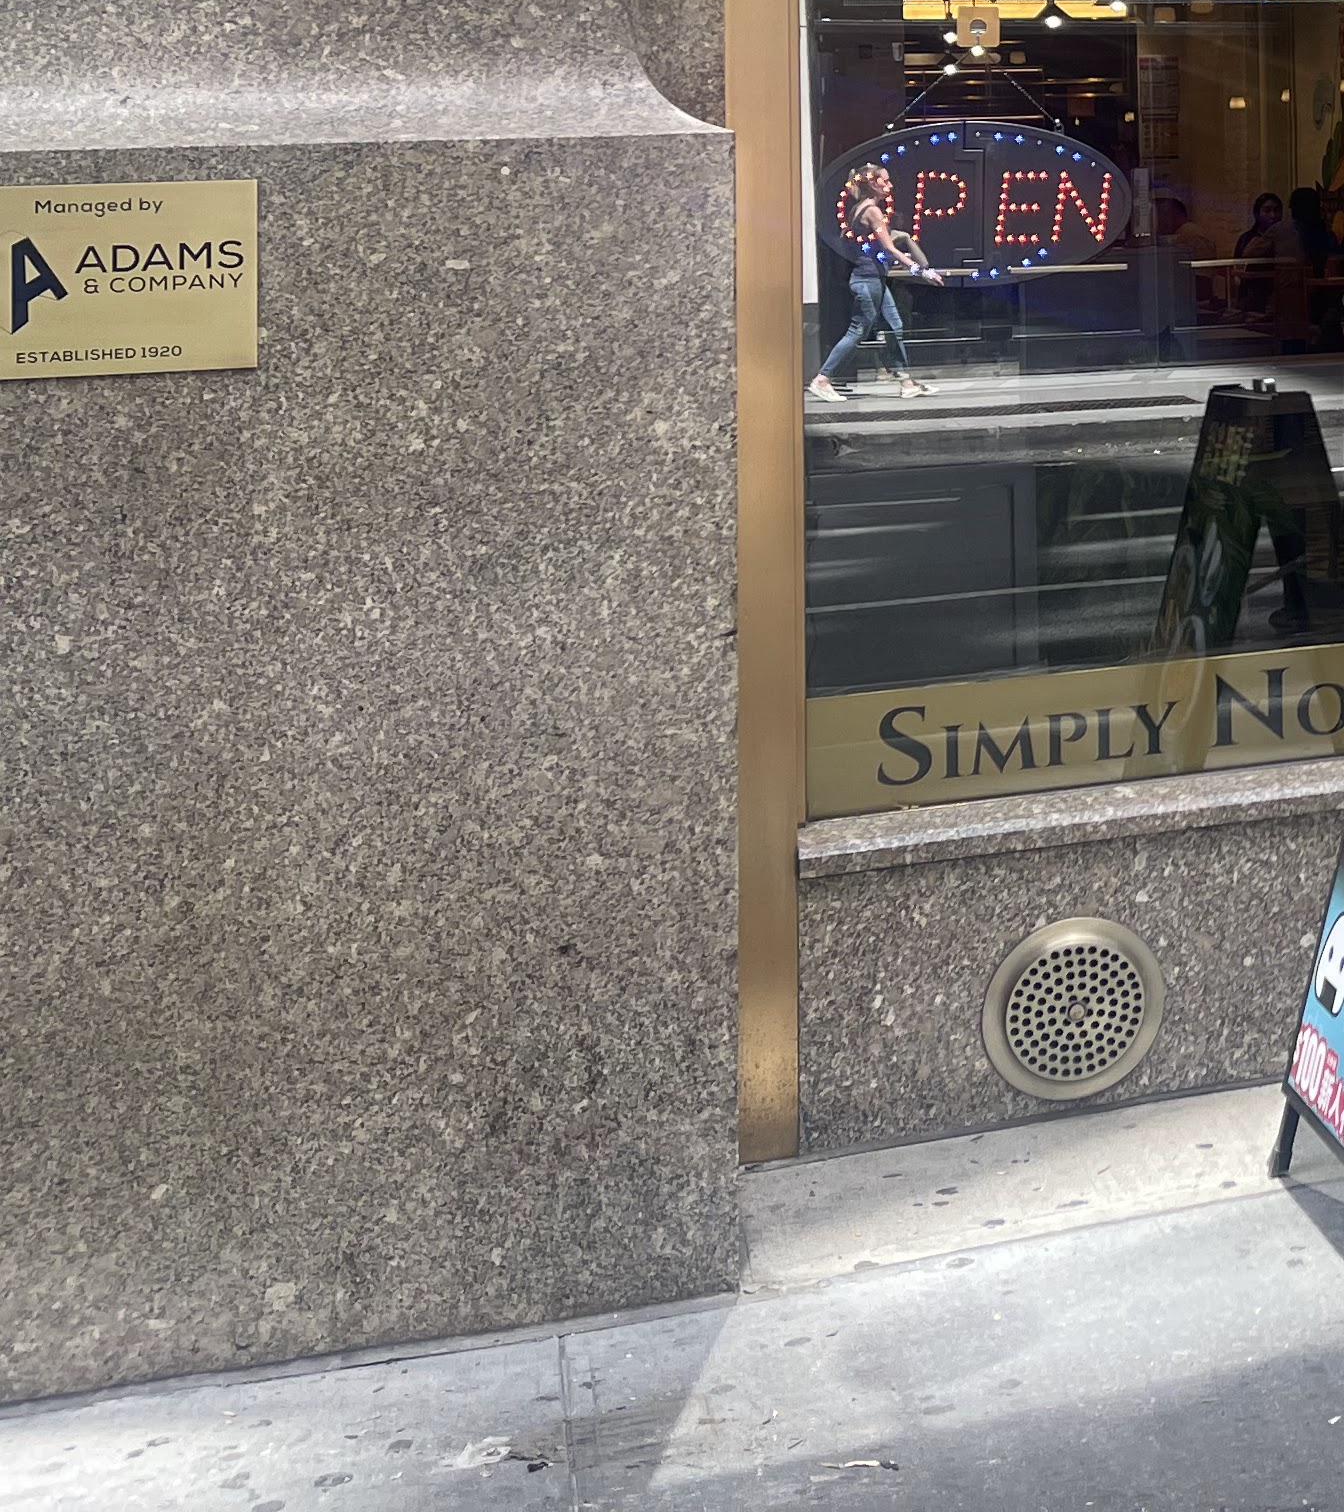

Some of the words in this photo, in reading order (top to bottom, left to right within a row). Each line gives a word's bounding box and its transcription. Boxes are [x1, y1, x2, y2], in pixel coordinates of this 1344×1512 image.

[34, 198, 132, 218] Managed
[139, 197, 164, 213] by
[837, 170, 1112, 245] OPEN
[74, 240, 245, 274] ADAMS
[11, 236, 68, 335] A
[83, 278, 100, 294] &
[109, 273, 244, 293] COMPANY
[16, 348, 137, 364] ESTABLISHED
[140, 345, 183, 358] 1920
[876, 699, 1179, 787] SIMPLY
